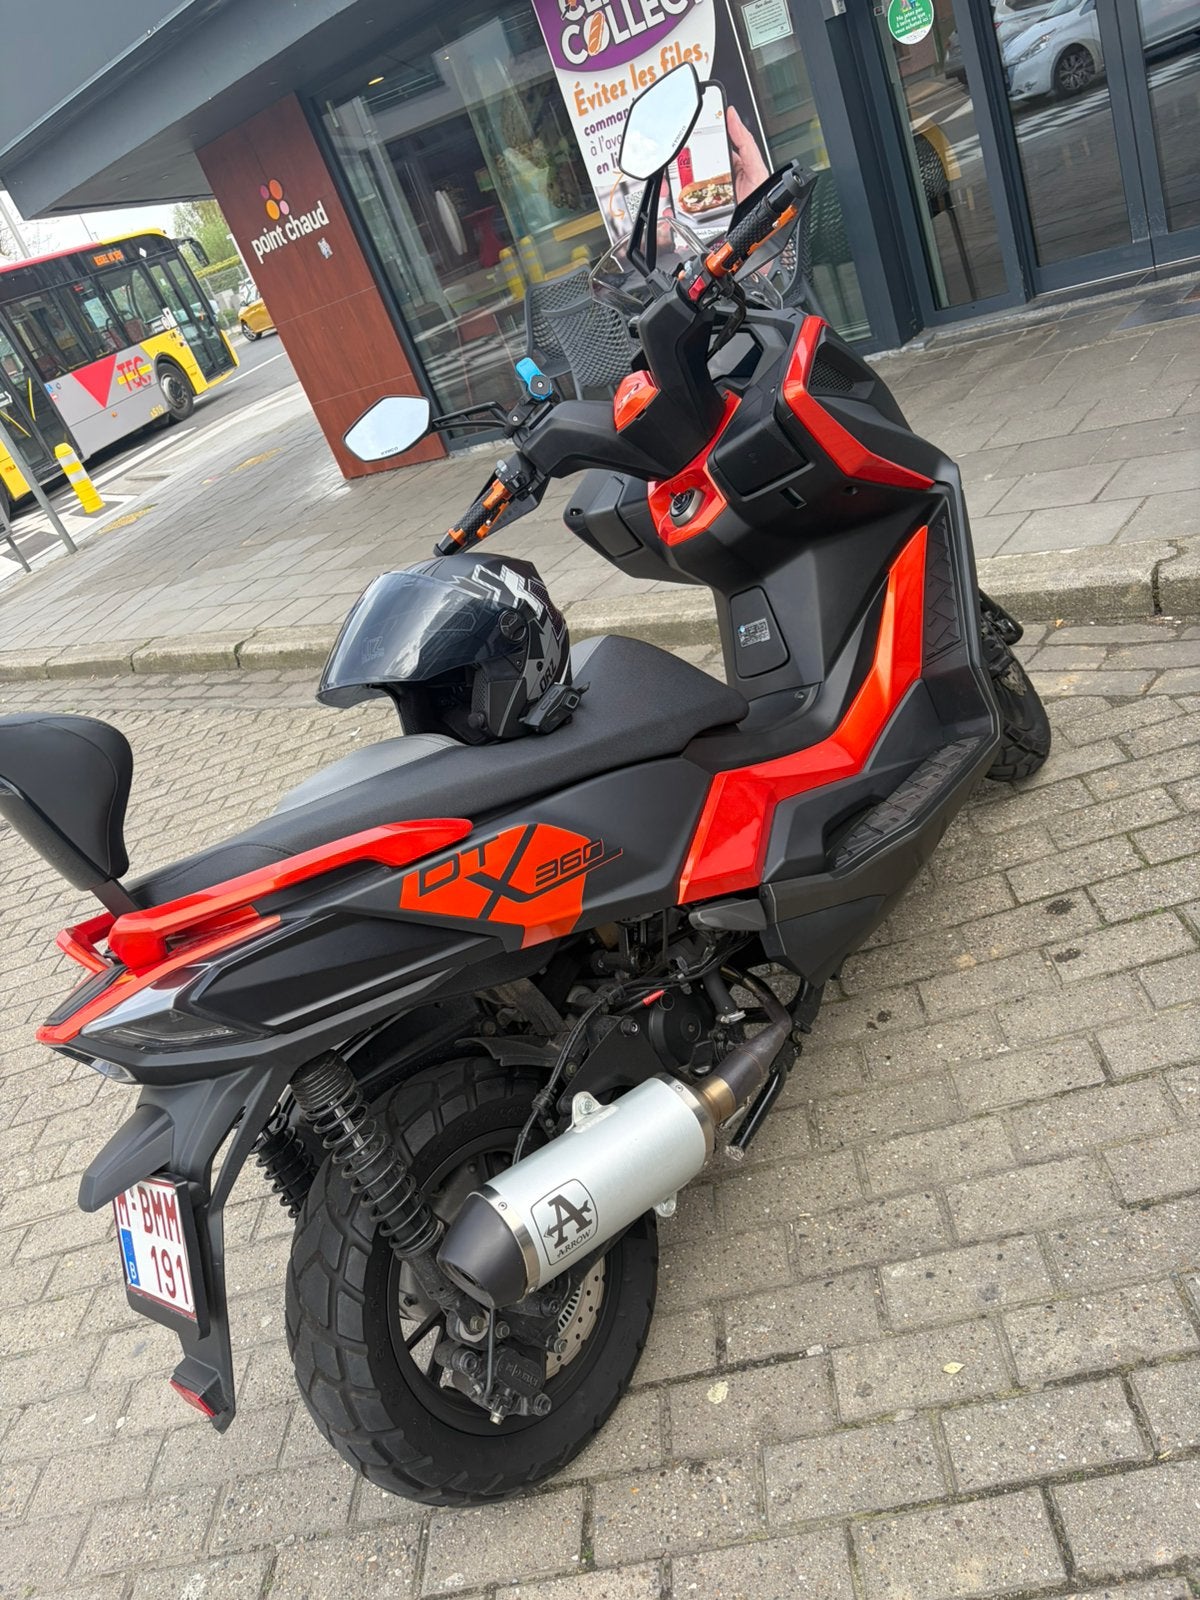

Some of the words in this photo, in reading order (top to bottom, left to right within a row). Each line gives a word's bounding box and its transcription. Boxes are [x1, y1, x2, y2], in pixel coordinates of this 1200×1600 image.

[561, 0, 701, 65] COLLE
[573, 79, 627, 117] Évitez
[629, 63, 657, 91] les
[584, 107, 630, 137] comman
[596, 162, 610, 175] en
[251, 224, 288, 265] point
[285, 199, 330, 241] chaud
[535, 838, 604, 888] 360
[557, 1229, 591, 1258] ARROW
[150, 1245, 190, 1305] 191
